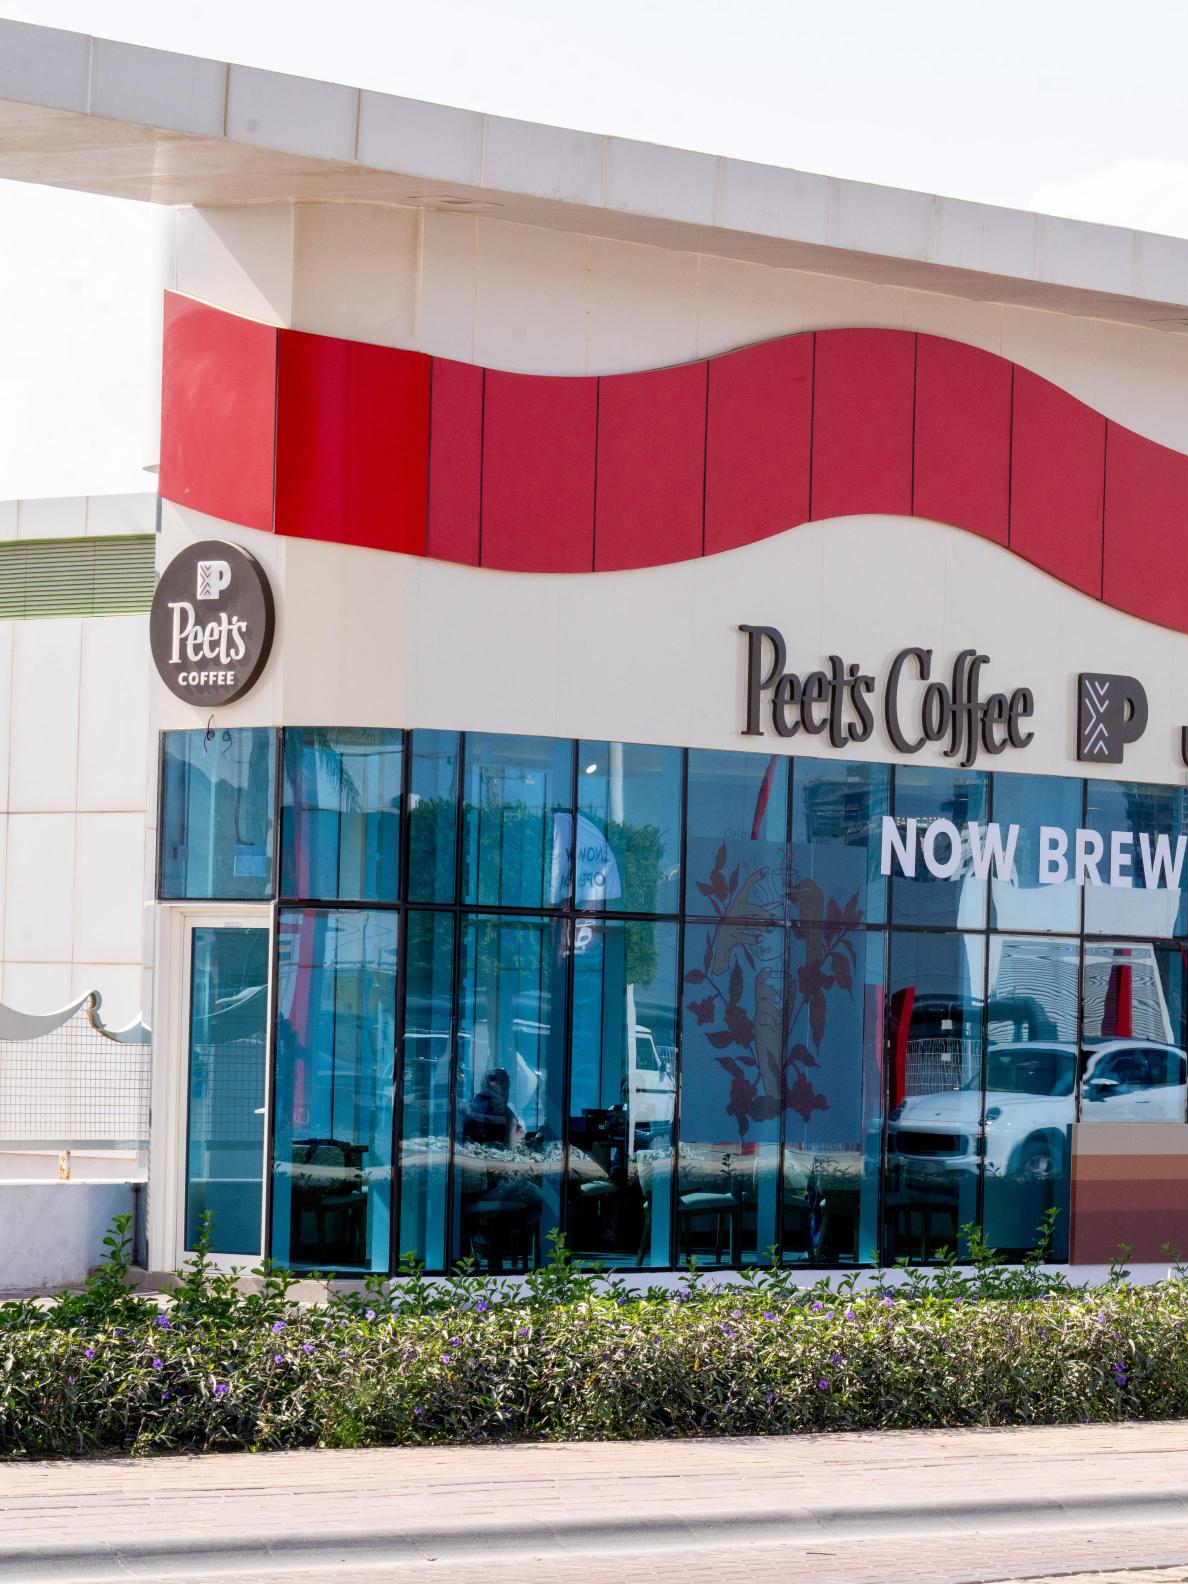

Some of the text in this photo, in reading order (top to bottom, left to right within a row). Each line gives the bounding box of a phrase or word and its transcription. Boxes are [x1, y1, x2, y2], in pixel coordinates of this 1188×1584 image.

[178, 671, 235, 686] COFFEE
[885, 647, 1035, 767] Coffee
[880, 816, 1020, 882] NOW
